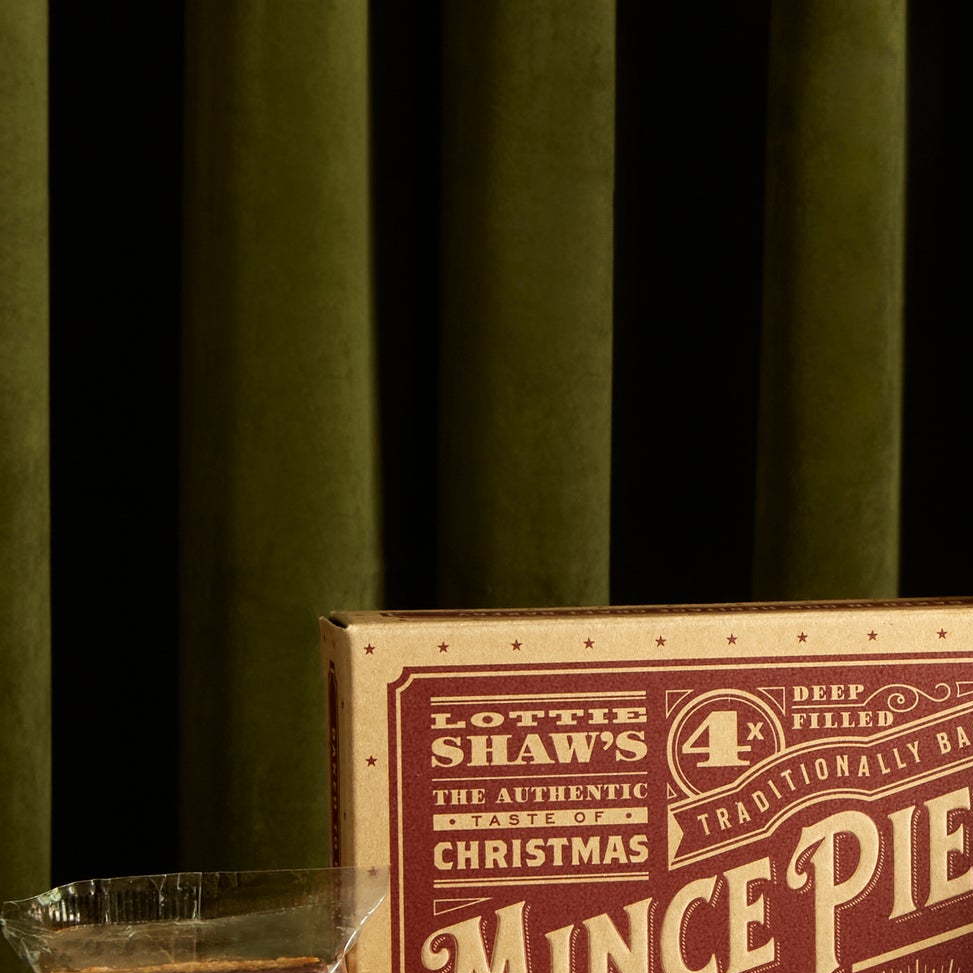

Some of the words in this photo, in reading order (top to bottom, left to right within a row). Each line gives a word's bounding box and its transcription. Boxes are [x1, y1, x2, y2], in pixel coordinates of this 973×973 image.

[793, 684, 865, 701] DEEP
[431, 707, 647, 729] LOTTIE
[792, 711, 894, 730] FILLED
[431, 731, 648, 768] SHAW'S
[433, 789, 486, 806] THE
[495, 783, 648, 804] AUTHENTIC
[697, 741, 921, 836] TRADITIONALLY
[472, 813, 555, 827] TASTE
[574, 811, 604, 823] OF
[433, 835, 649, 871] CHRISTMAS
